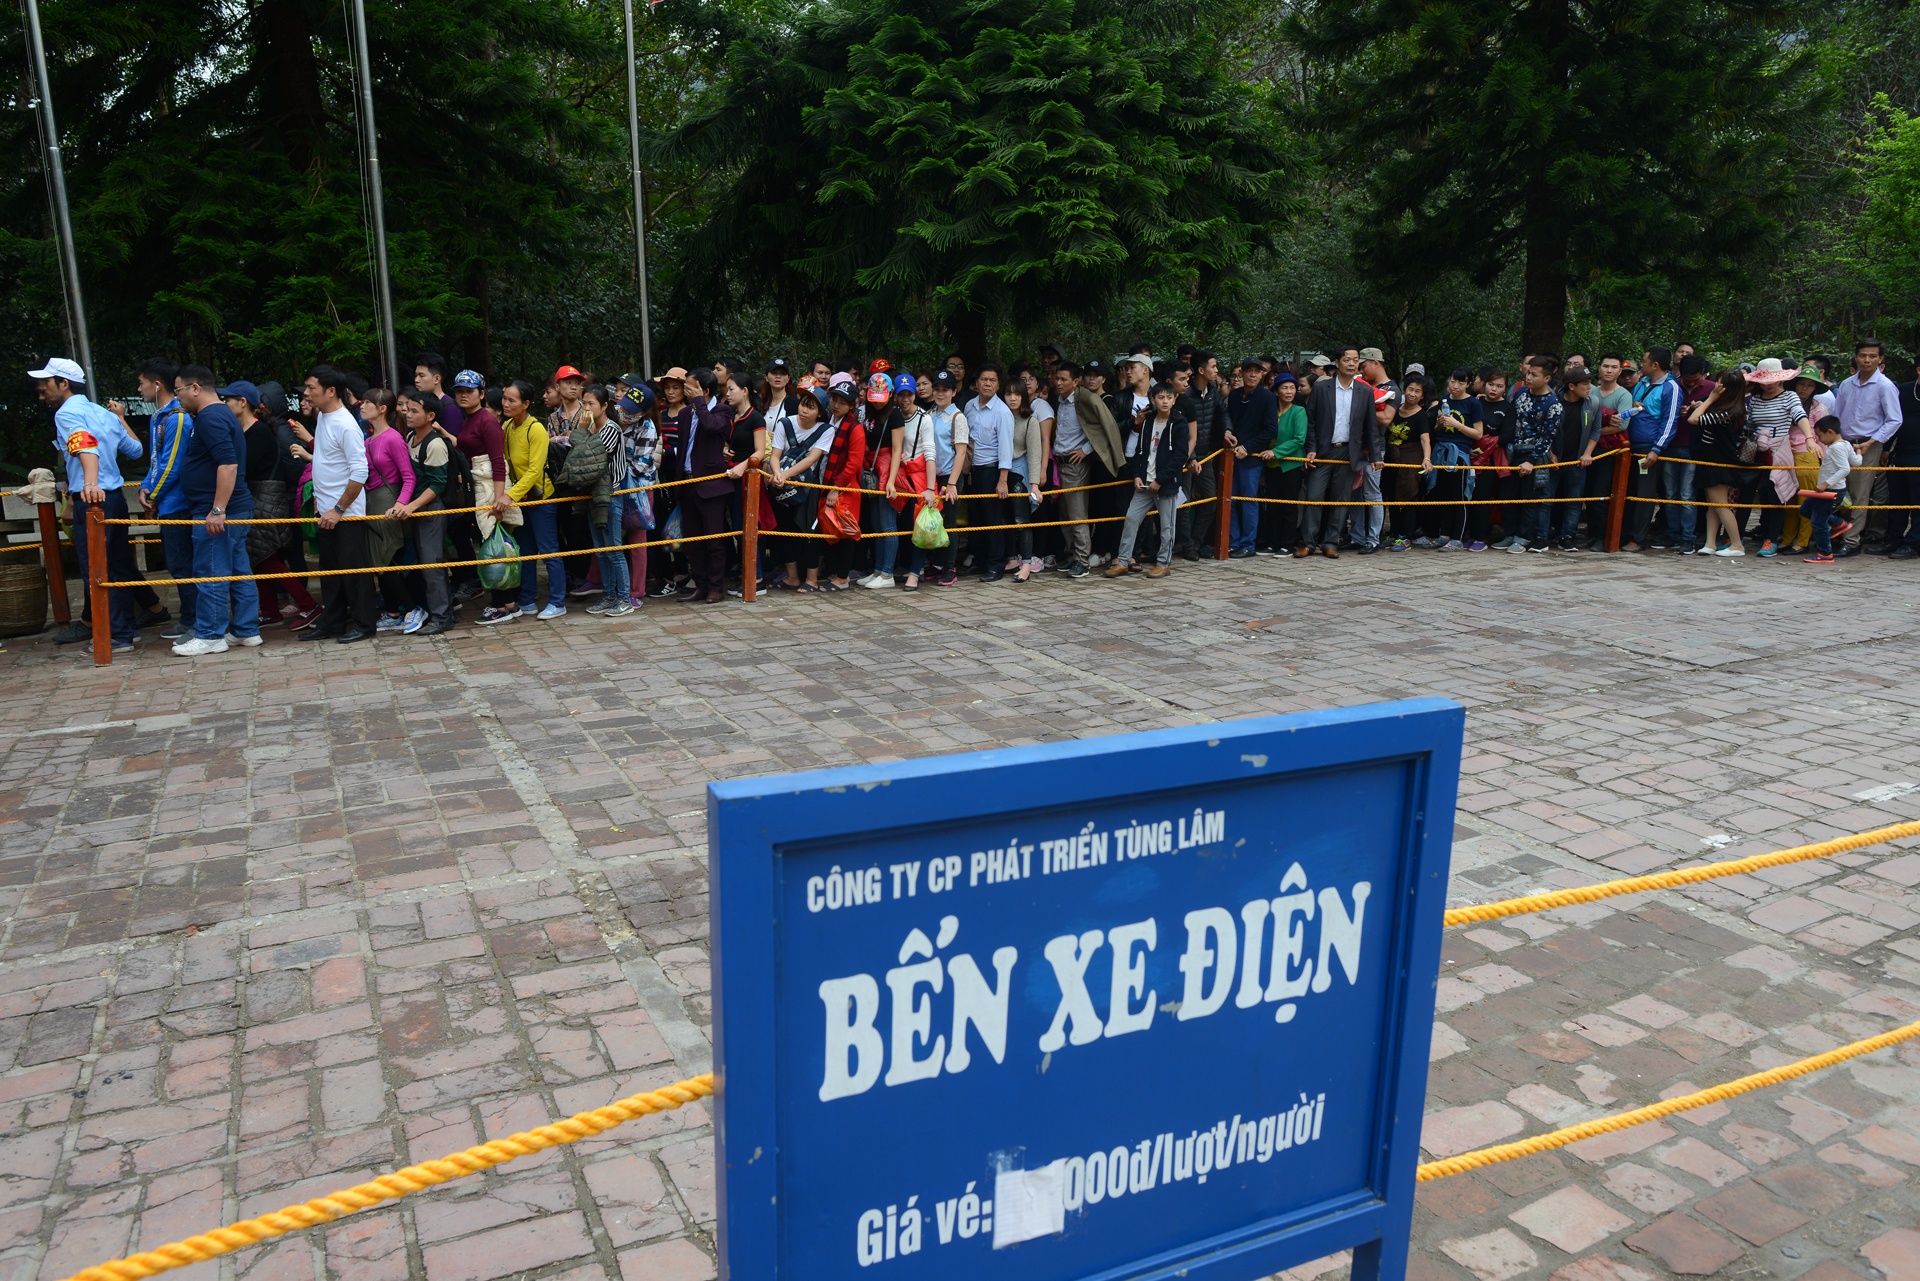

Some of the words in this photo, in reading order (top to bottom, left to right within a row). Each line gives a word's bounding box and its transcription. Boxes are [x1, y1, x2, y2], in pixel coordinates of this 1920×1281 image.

[806, 864, 883, 914] CÔNG
[889, 860, 922, 900] TY
[927, 854, 963, 894] CP
[969, 837, 1035, 888] PHÁT
[1039, 820, 1109, 876] TRIỂN
[1114, 819, 1173, 862] TÙNG
[1177, 807, 1226, 851] LÂM
[818, 915, 1018, 1103] BẾN
[1038, 917, 1158, 1054] XE
[1176, 861, 1372, 1024] ĐIỆN
[856, 1194, 923, 1268] Giá
[935, 1180, 993, 1246] vé:
